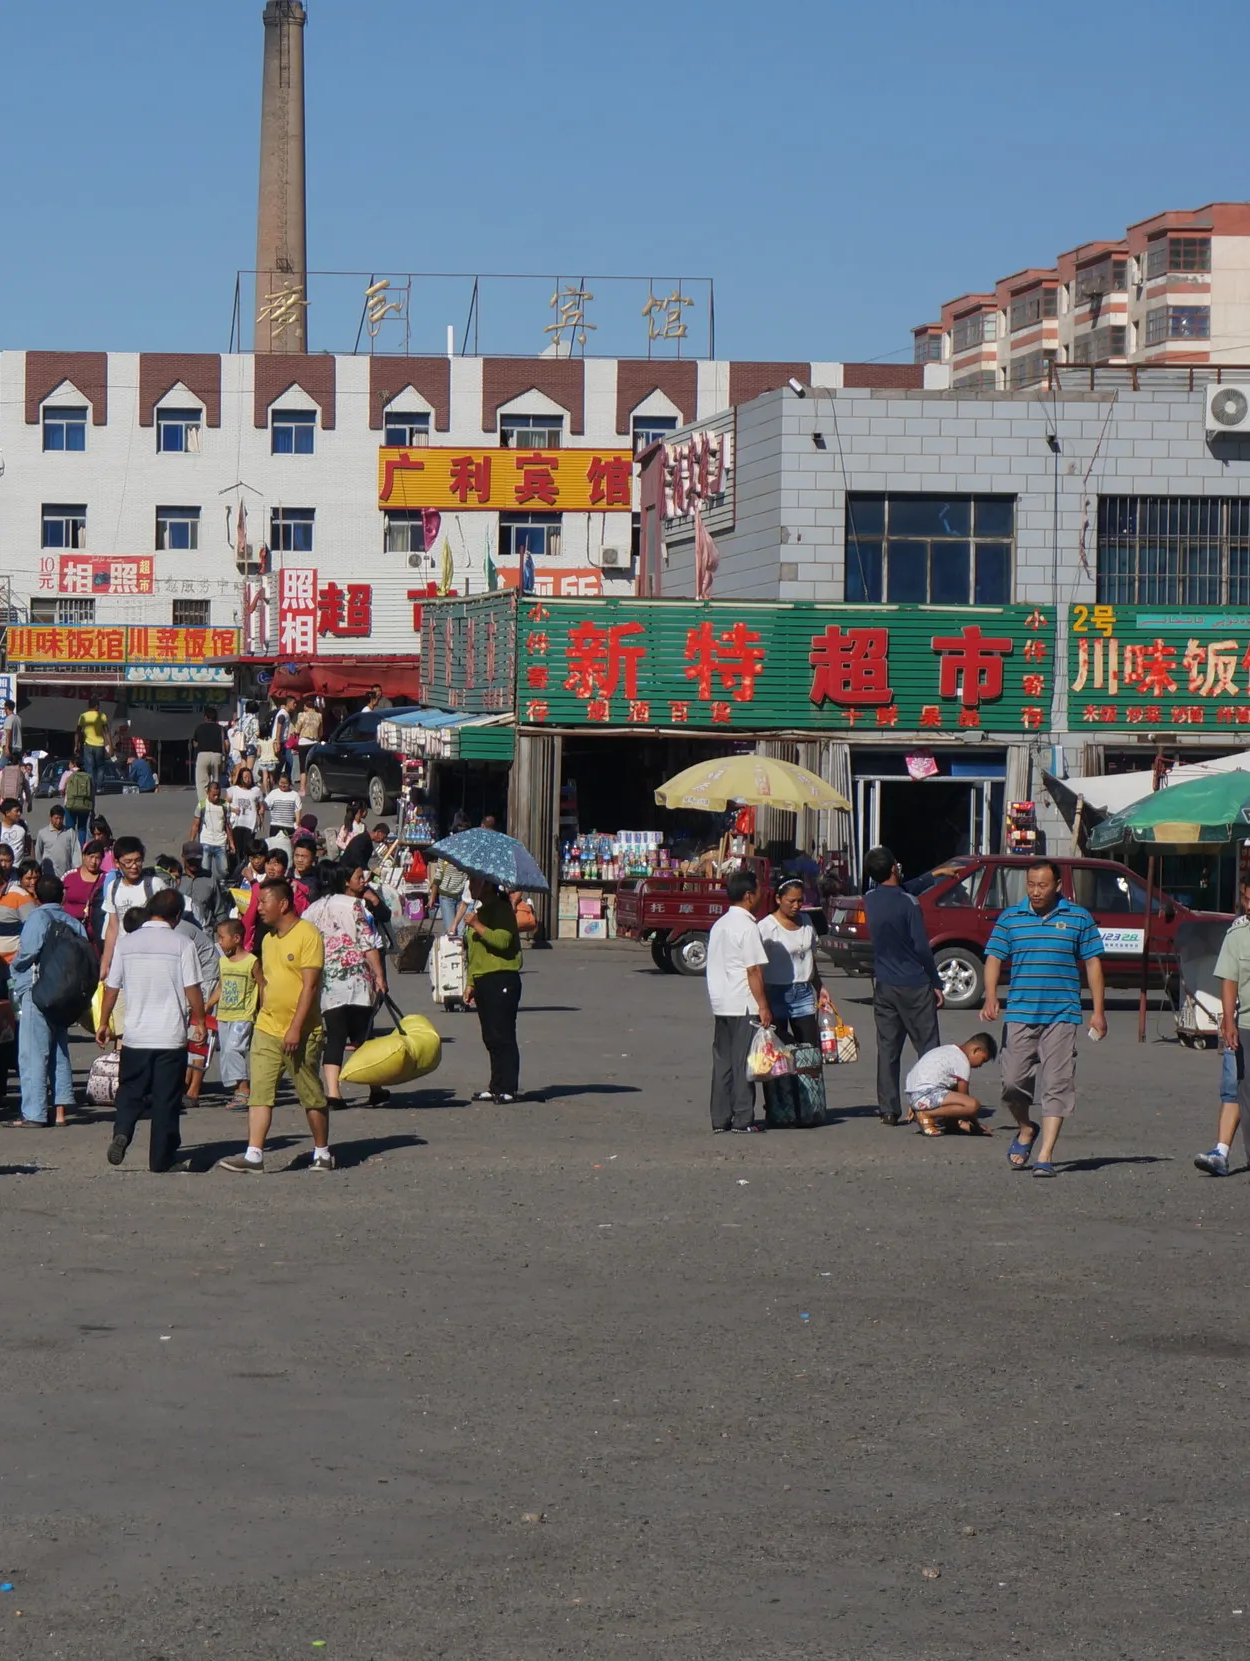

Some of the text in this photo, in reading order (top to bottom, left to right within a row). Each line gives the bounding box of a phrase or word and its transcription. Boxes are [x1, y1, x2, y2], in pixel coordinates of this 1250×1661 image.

[380, 453, 632, 506] 广利宾馆
[39, 557, 55, 572] 10
[39, 574, 54, 590] 元
[281, 569, 315, 654] 照相
[1072, 605, 1117, 637] 2号
[7, 628, 124, 660] 川味饭馆
[128, 627, 236, 658] 川菜饭馆
[1021, 608, 1049, 729] 小件寄存
[1070, 638, 1250, 697] 川味饭
[586, 700, 732, 723] 烟酒百货
[1083, 704, 1118, 723] 米饭
[1126, 706, 1162, 724] 炒菜
[1170, 706, 1204, 724] 炒面
